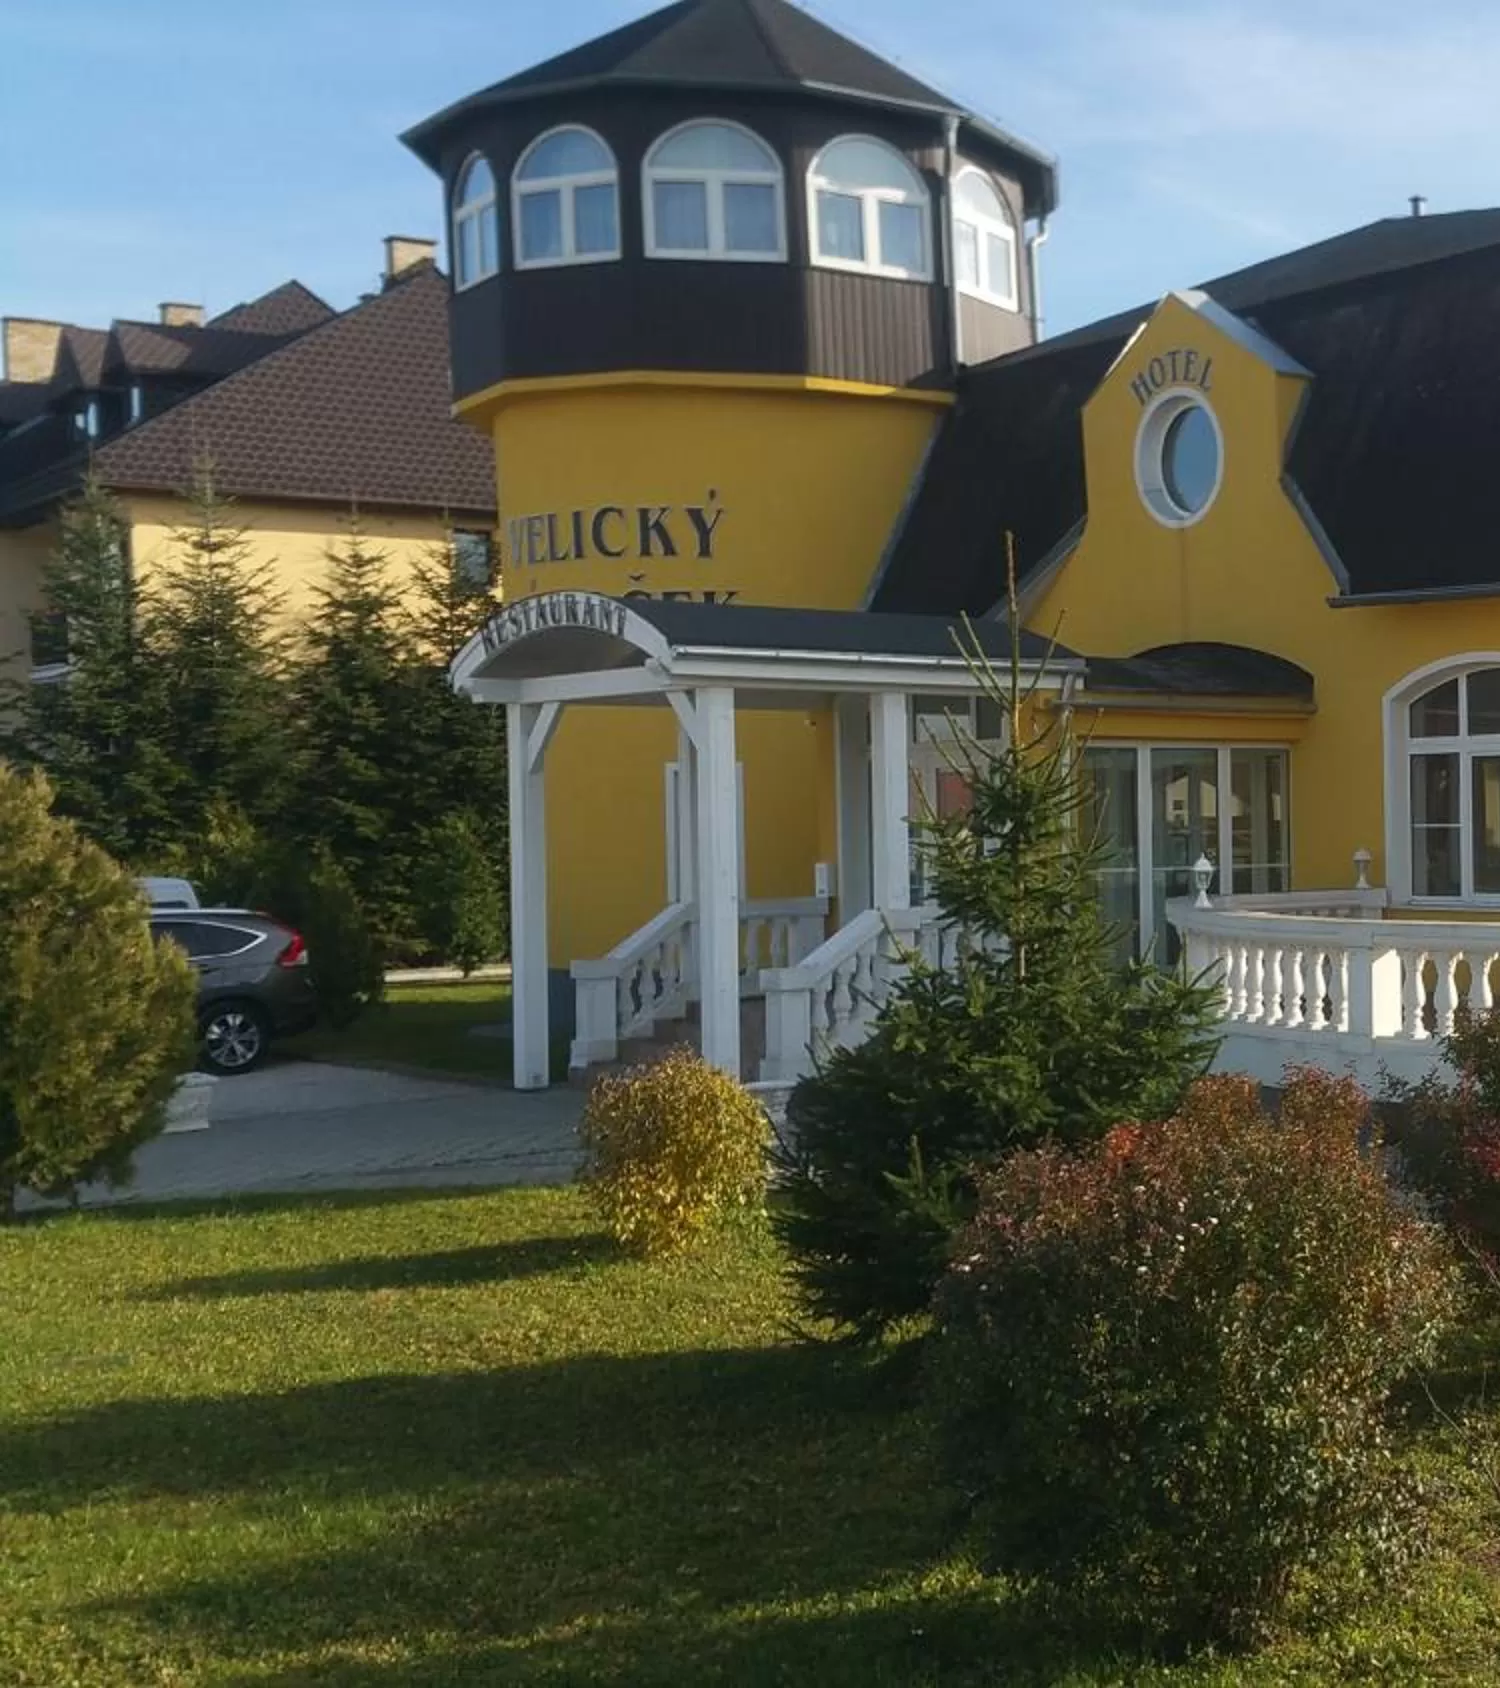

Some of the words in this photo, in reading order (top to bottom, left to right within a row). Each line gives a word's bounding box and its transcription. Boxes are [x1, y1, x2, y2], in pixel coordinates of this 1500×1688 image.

[1130, 348, 1213, 406] HOTEL
[506, 488, 725, 569] VELICKÝ
[480, 592, 627, 654] RESTAURANT
